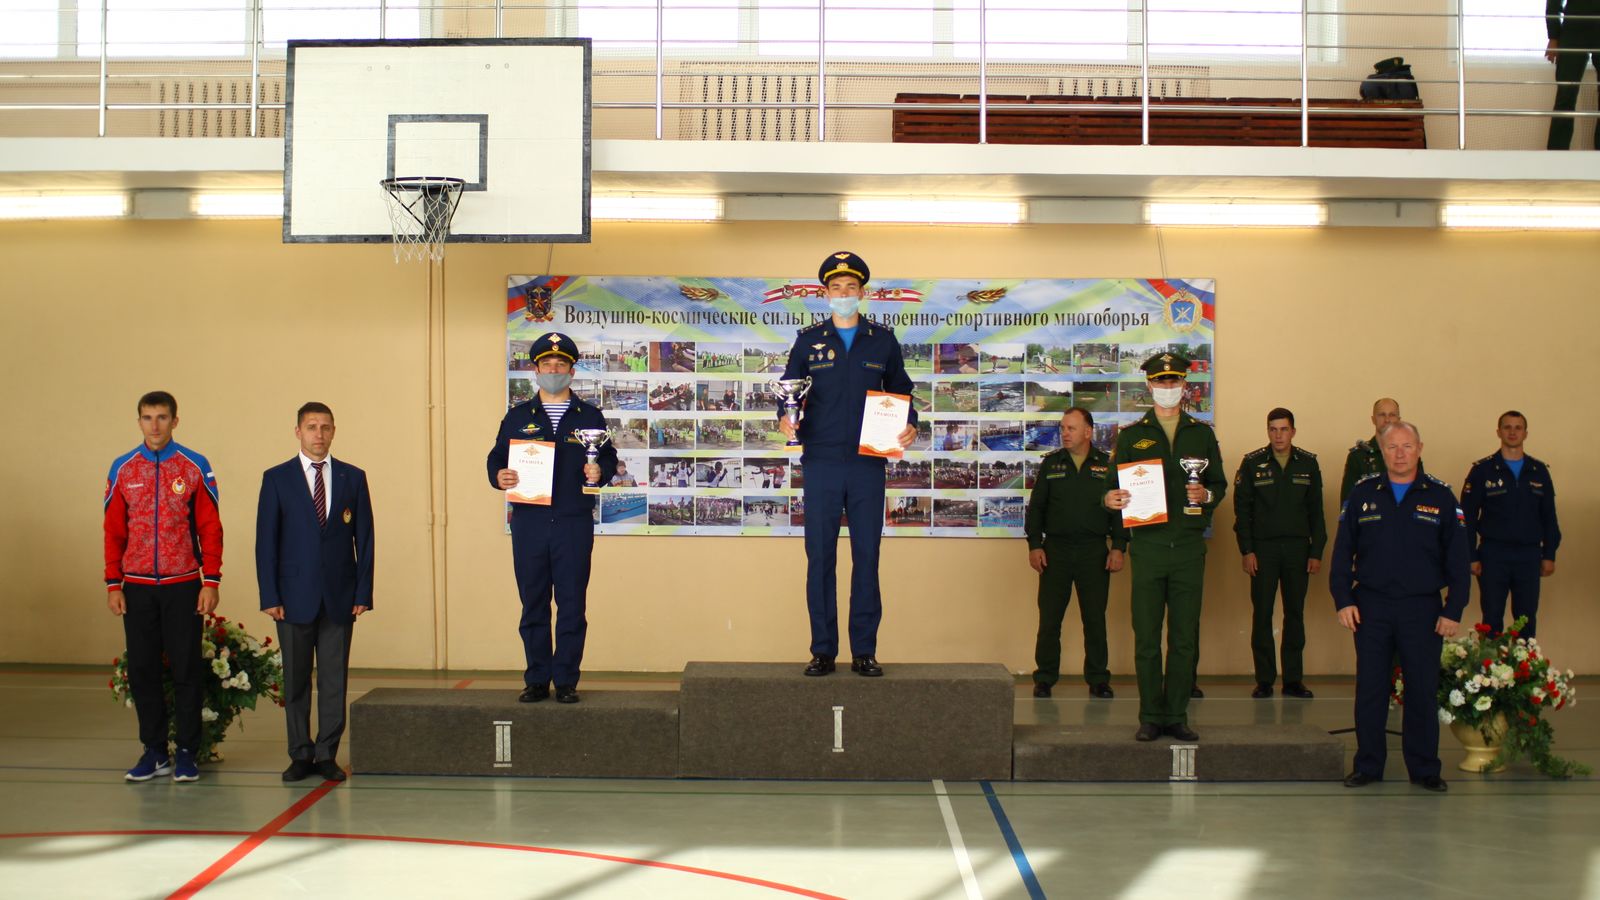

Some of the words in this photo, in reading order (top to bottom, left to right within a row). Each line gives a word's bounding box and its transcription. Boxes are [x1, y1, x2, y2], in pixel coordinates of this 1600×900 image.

[565, 304, 757, 329] Воздушно-космические
[762, 311, 804, 325] силы
[883, 312, 1049, 331] военно-спортивного
[1054, 307, 1149, 331] многоборья
